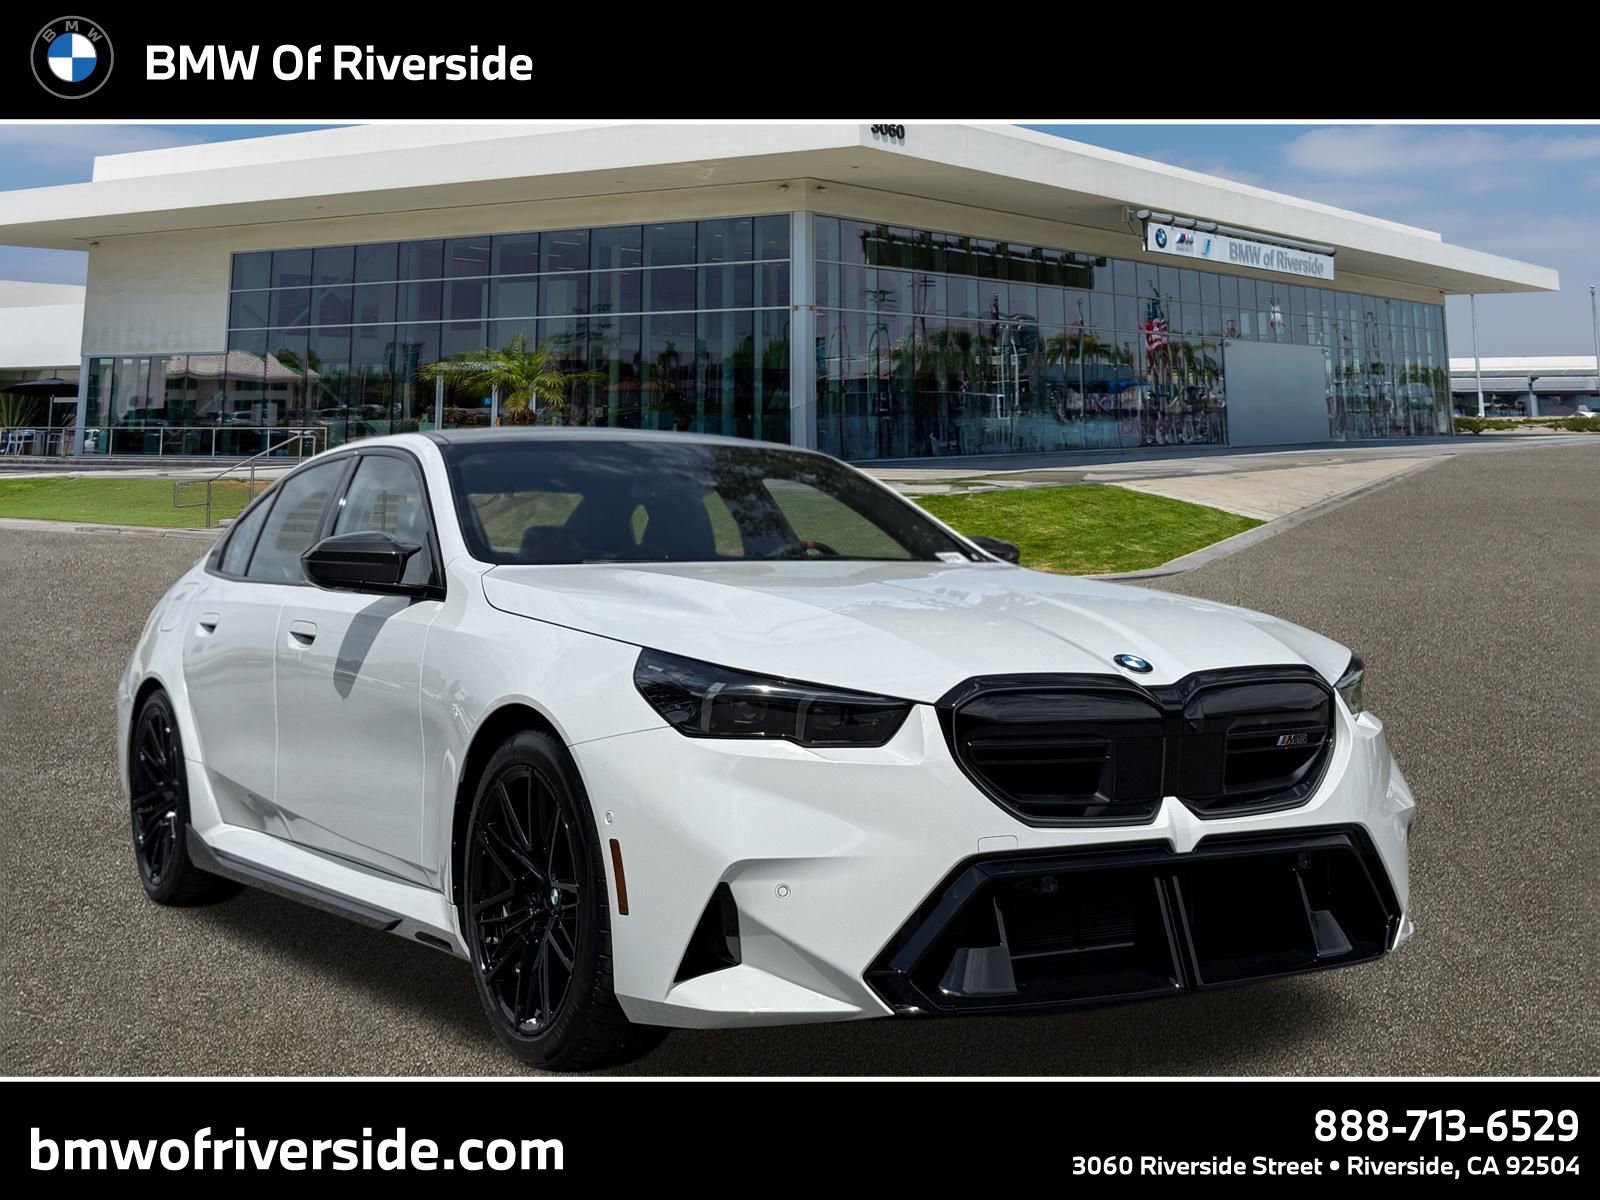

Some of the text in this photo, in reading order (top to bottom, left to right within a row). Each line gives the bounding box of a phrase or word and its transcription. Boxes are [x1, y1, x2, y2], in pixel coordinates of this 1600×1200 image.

[1228, 240, 1261, 265] BMW
[1262, 252, 1276, 267] of
[1276, 251, 1325, 275] Riverside
